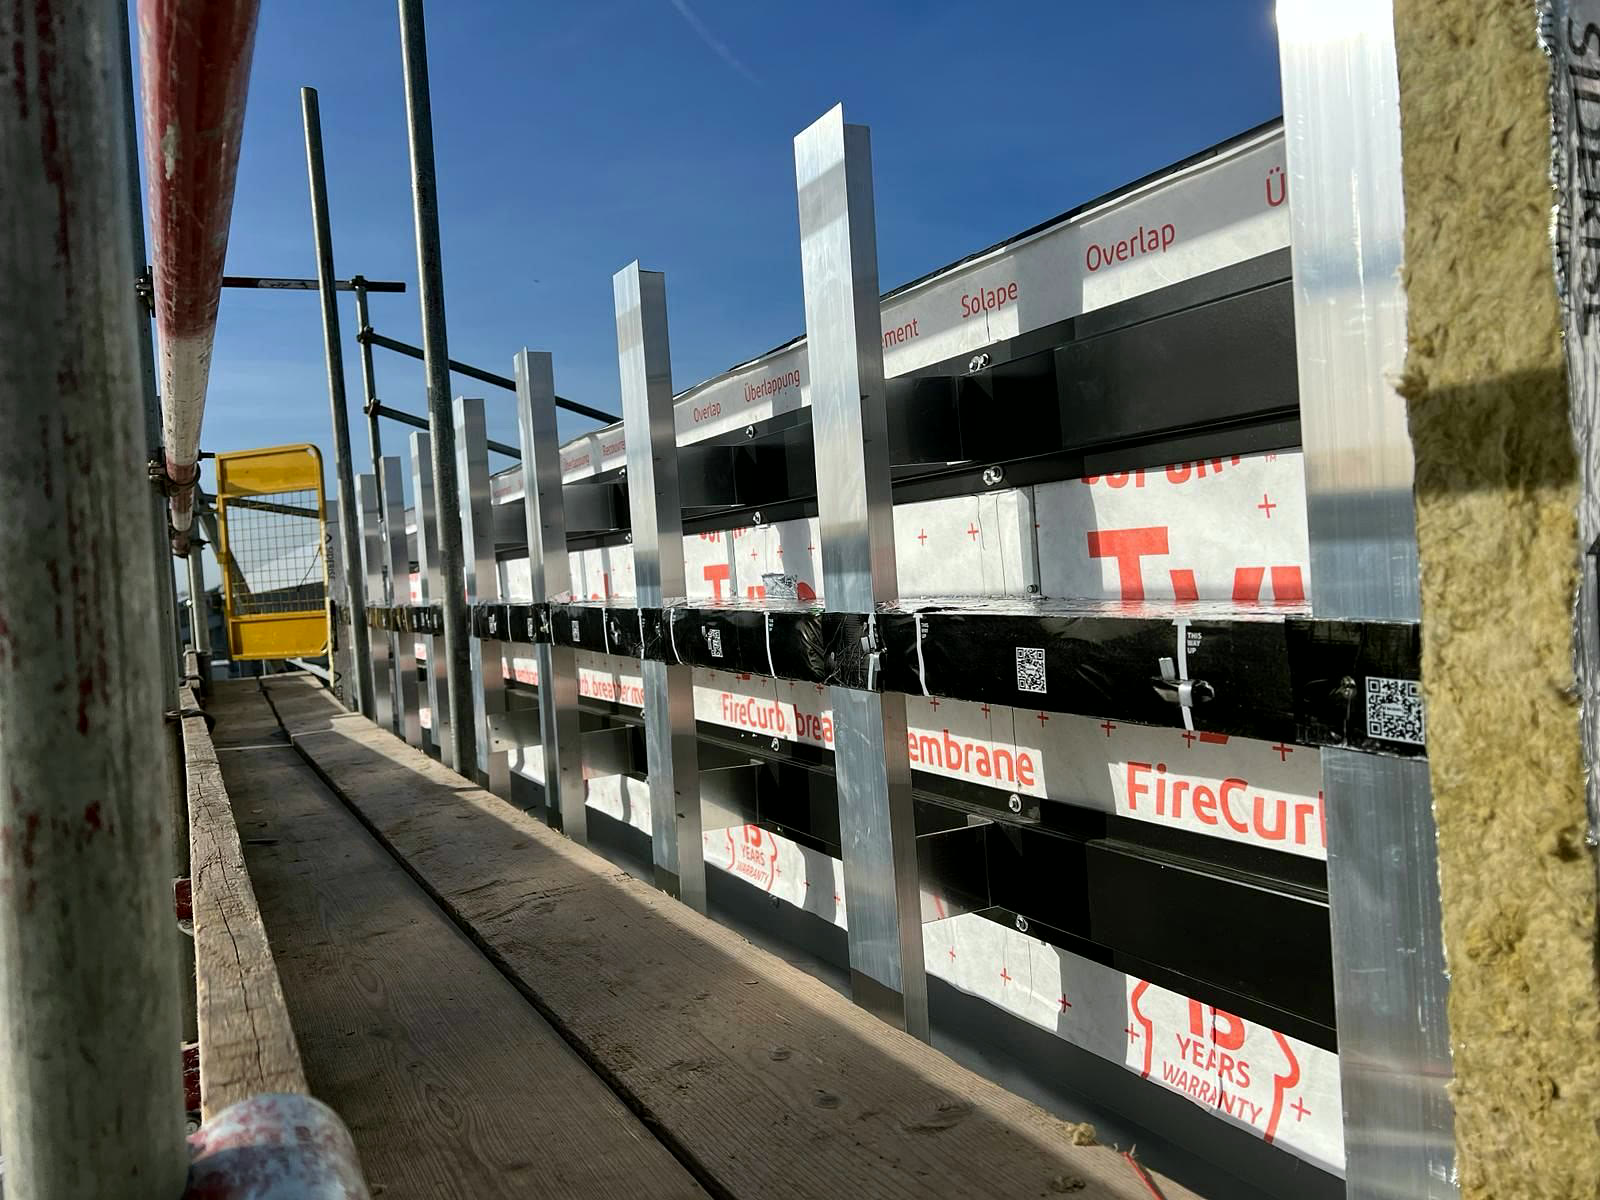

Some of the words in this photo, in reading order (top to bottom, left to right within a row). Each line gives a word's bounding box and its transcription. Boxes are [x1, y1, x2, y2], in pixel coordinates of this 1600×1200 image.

[1086, 223, 1175, 272] Overlap
[961, 280, 1018, 319] Solape
[882, 317, 919, 348] ment
[744, 370, 801, 402] Überlappung
[693, 402, 721, 422] Overlap
[742, 844, 766, 866] YEARS
[736, 861, 769, 884] WARRANTY
[1176, 1033, 1251, 1088] YEARS
[1163, 1060, 1263, 1124] WARRANTY
